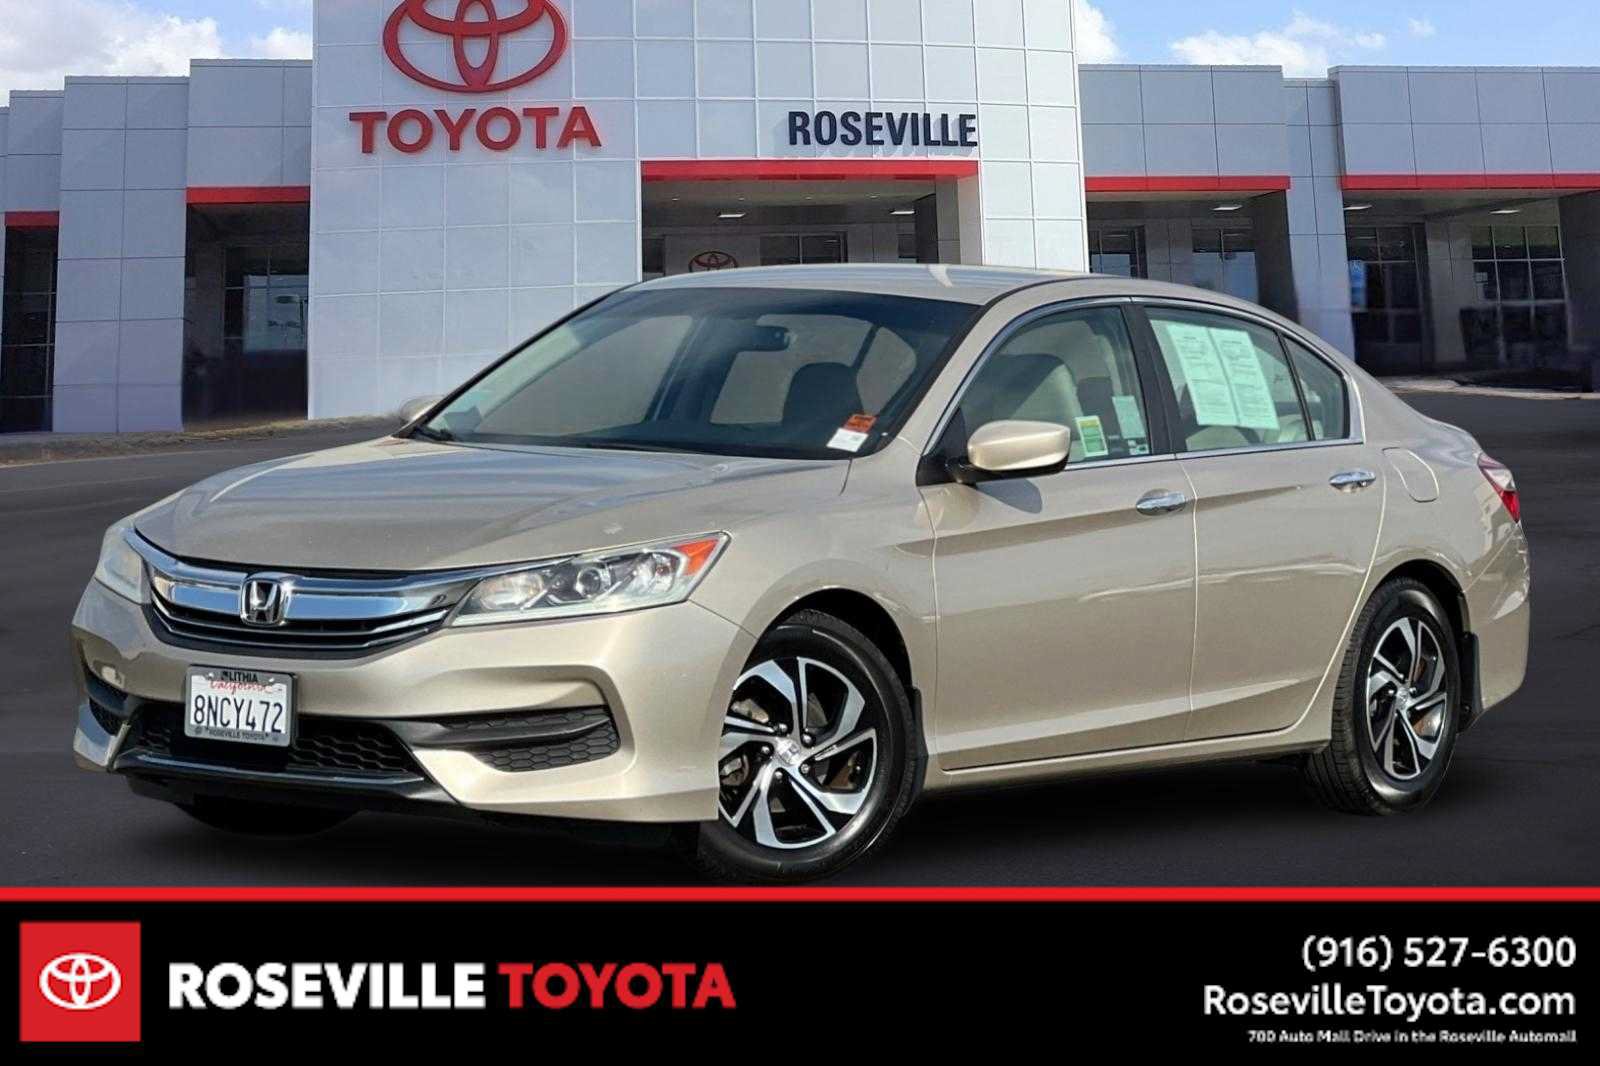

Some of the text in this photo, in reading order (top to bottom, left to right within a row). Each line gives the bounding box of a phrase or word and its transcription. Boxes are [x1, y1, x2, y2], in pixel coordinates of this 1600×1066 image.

[349, 106, 603, 153] TOYOTA
[788, 111, 978, 146] ROSEVILLE
[229, 670, 258, 682] LITHIA
[194, 695, 283, 733] 8NCY472
